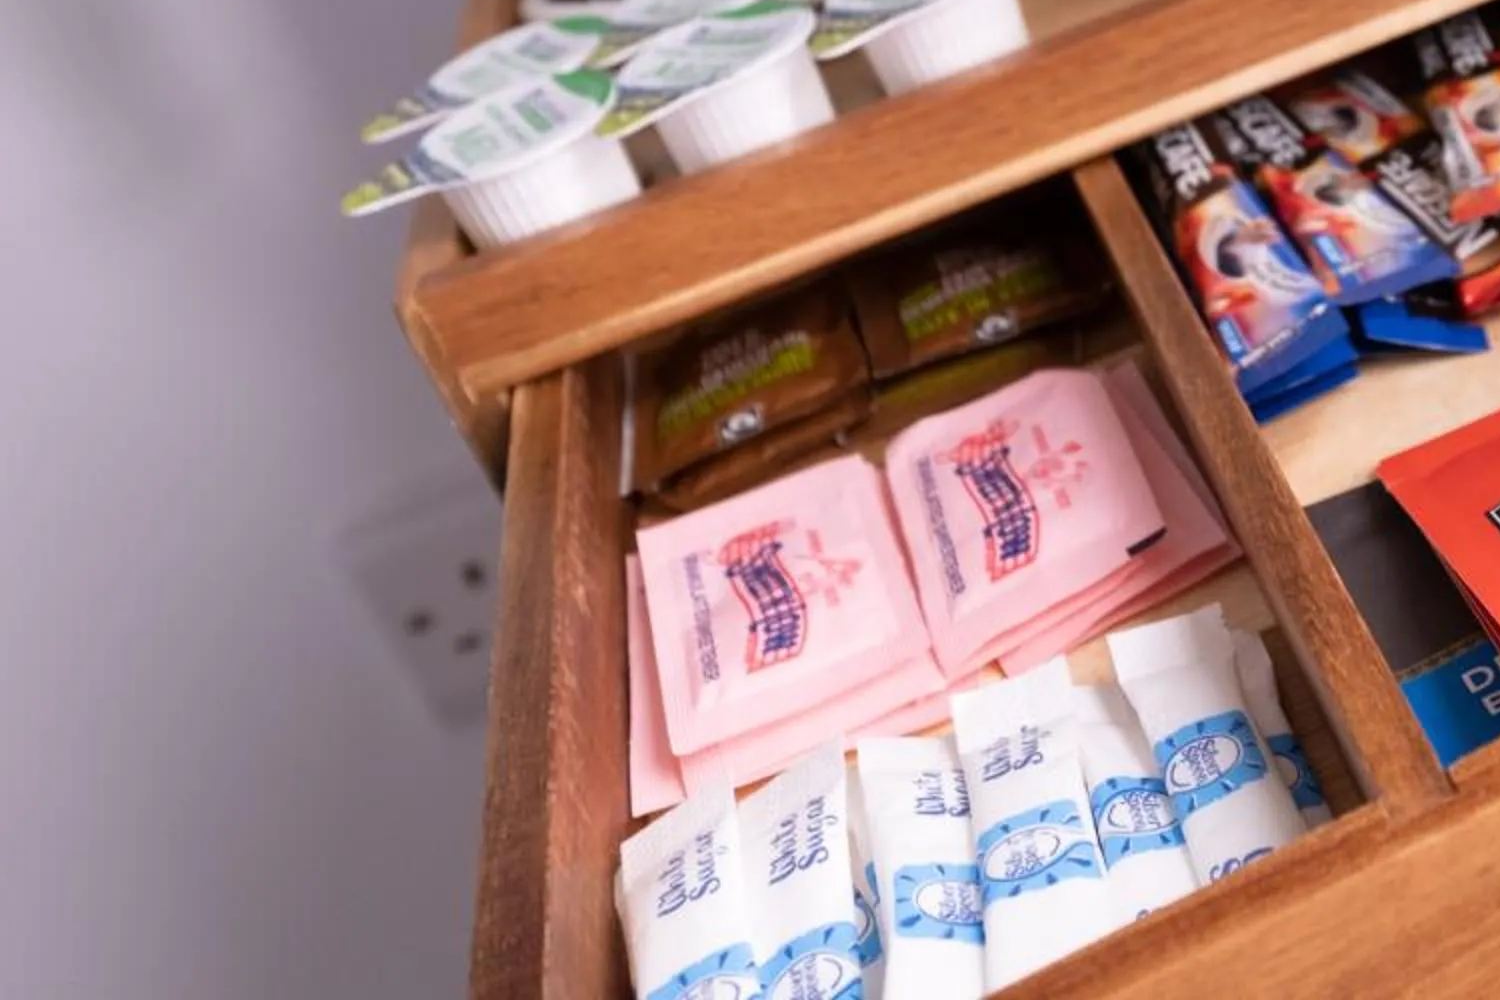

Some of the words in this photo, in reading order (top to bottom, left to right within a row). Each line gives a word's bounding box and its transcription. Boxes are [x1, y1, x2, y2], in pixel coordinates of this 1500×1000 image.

[688, 829, 730, 901] Sugar
[768, 811, 799, 887] White
[796, 794, 839, 871] Sugar
[656, 849, 689, 919] White
